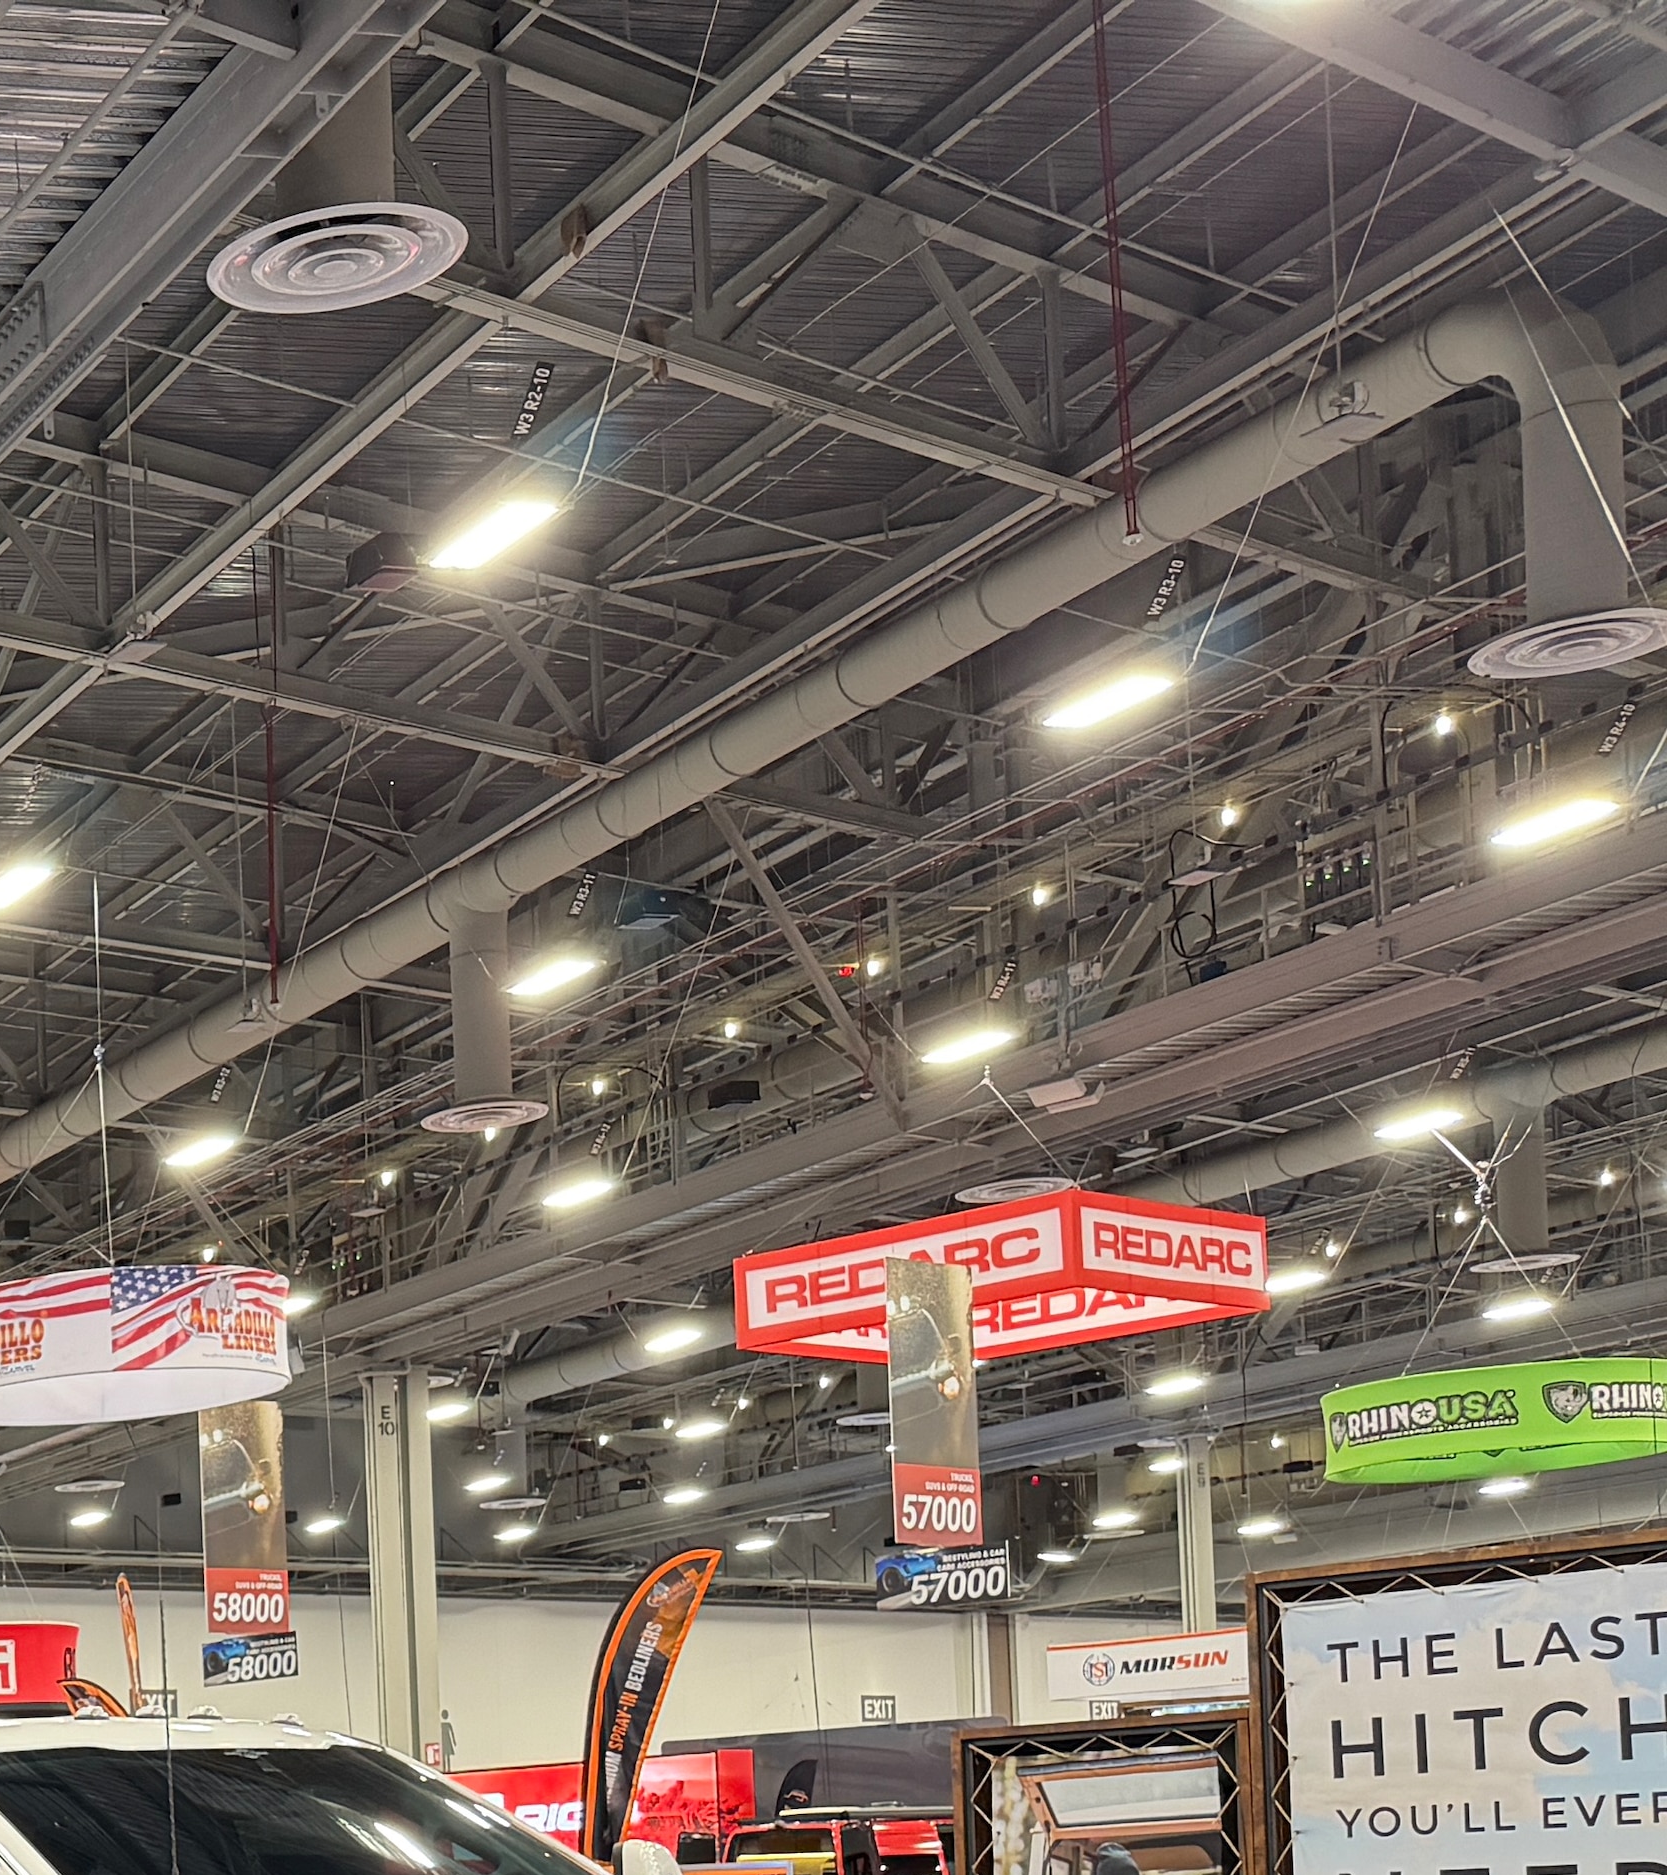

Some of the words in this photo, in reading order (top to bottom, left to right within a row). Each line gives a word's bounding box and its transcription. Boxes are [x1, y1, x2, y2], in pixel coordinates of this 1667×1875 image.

[514, 413, 534, 435] W3
[524, 367, 550, 410] R2-10
[1147, 597, 1166, 615] W3
[1158, 560, 1184, 595] R3-10
[1598, 736, 1617, 752] W3
[1094, 1221, 1253, 1276] REDARC
[378, 1421, 396, 1435] 10
[381, 1405, 391, 1419] E
[901, 1493, 977, 1533] 57000
[910, 1565, 1006, 1605] 57000
[212, 1592, 285, 1623] 58000
[1119, 1650, 1229, 1675] MORSUN
[1327, 1632, 1458, 1683] THE
[1495, 1611, 1667, 1670] LAST
[227, 1650, 296, 1683] 58000
[608, 1692, 639, 1751] SPRAY-IN
[624, 1621, 663, 1691] BEDLINERS
[863, 1698, 894, 1720] EXIT
[1092, 1701, 1119, 1719] EXIT
[1331, 1694, 1667, 1779] HITCH
[1335, 1800, 1516, 1838] YOU'LL
